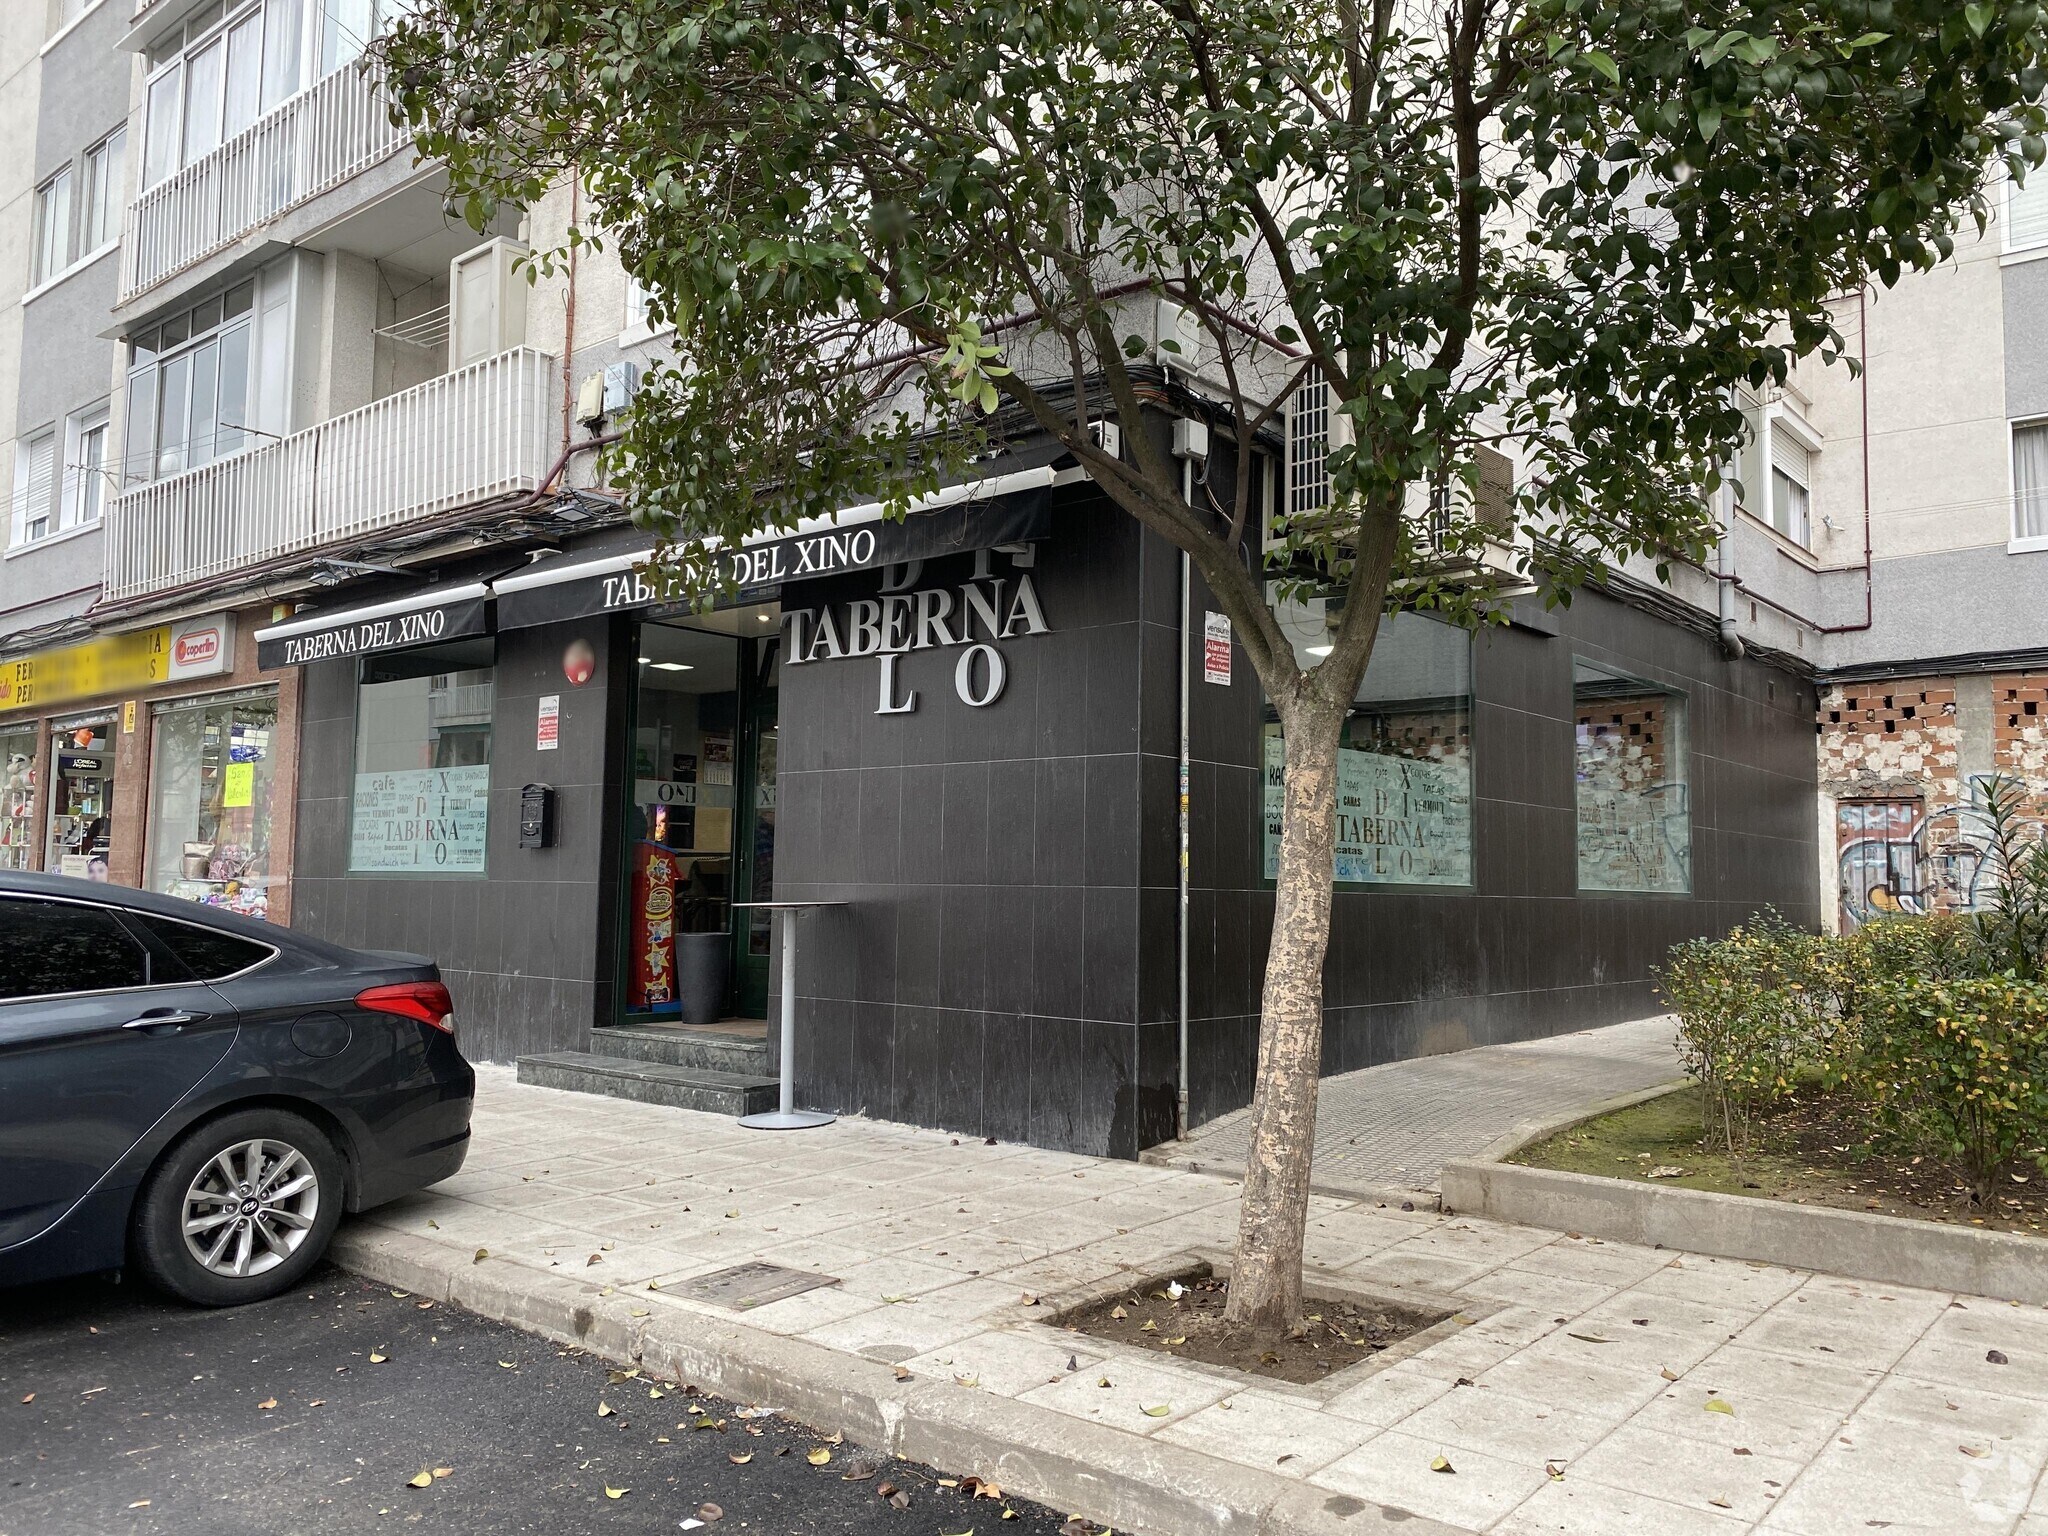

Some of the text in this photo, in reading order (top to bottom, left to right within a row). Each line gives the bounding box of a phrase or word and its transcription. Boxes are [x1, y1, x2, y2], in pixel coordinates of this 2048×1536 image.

[732, 546, 786, 586] DEL
[792, 529, 876, 575] XINO
[285, 609, 445, 664] TABERNA DEL XINO
[780, 573, 1052, 665] TABERNA
[1206, 641, 1229, 654] Alarma
[384, 818, 460, 842] TABERNA
[1336, 813, 1425, 848] TABERNA
